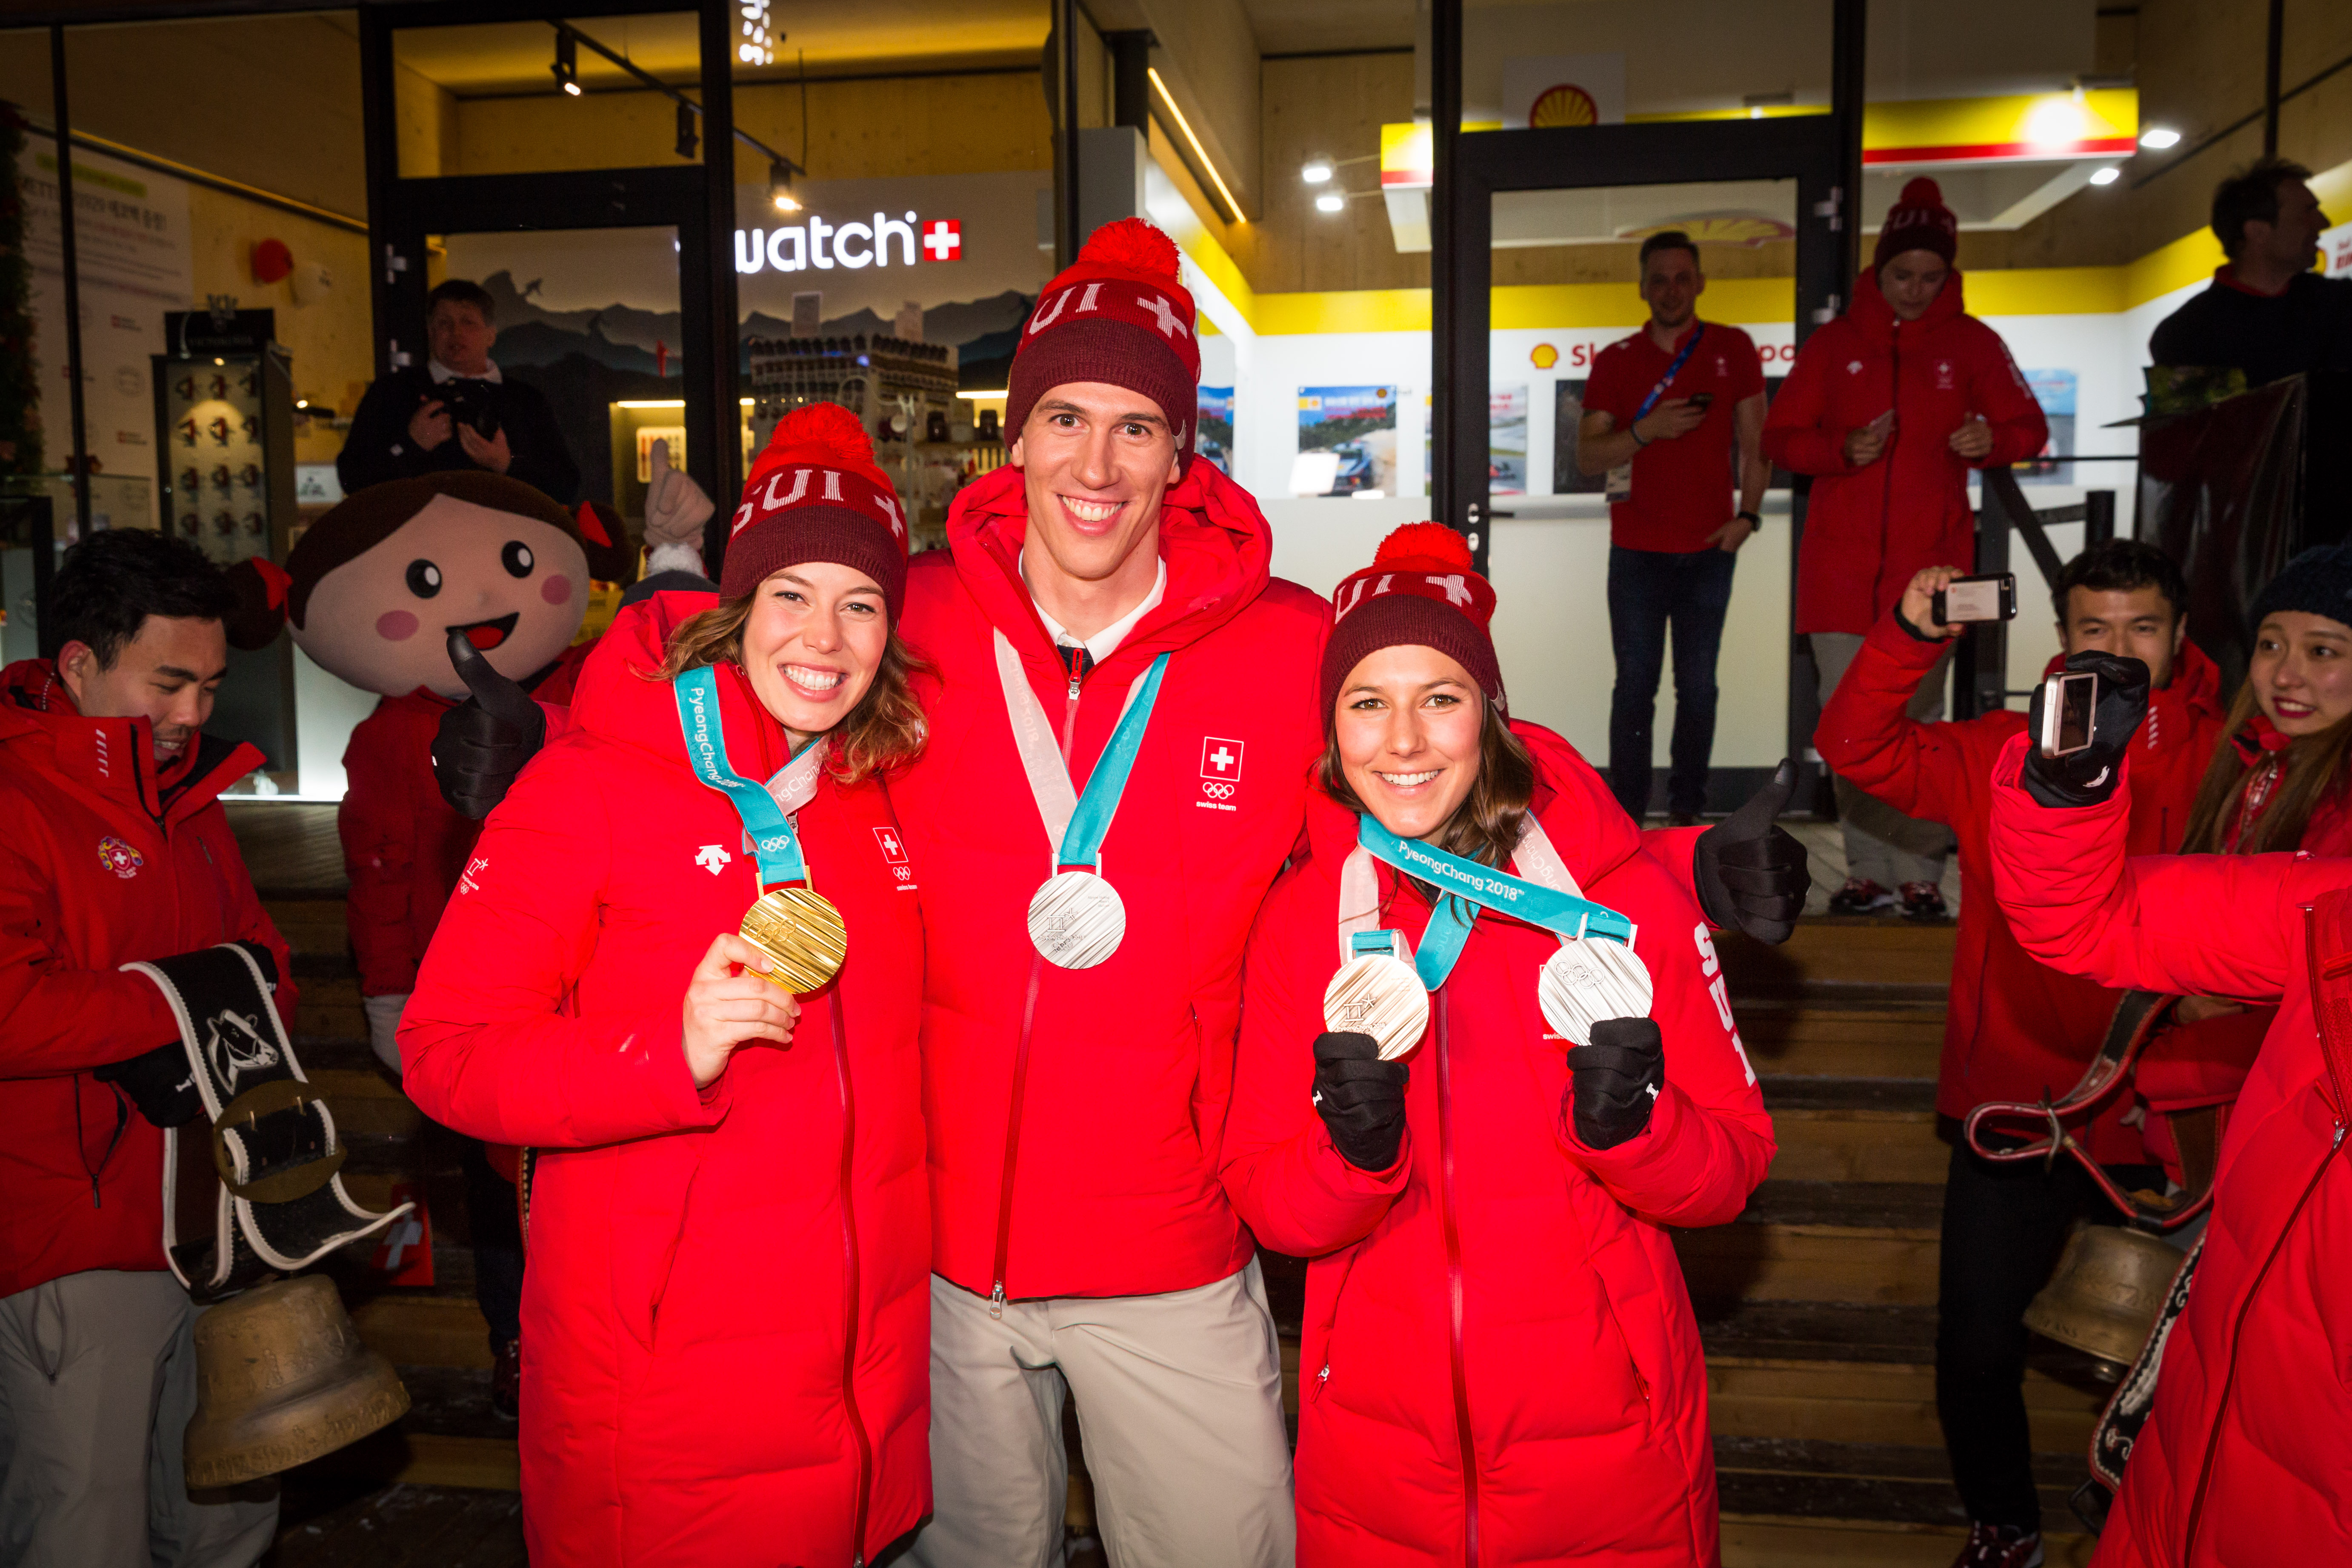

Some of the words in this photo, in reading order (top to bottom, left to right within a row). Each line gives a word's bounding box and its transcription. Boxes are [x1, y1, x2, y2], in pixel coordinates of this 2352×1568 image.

[689, 687, 723, 780] PyeongChang
[1218, 803, 1236, 811] team
[1398, 840, 1484, 891] PyeongChang
[1694, 921, 1756, 1088] SUI
